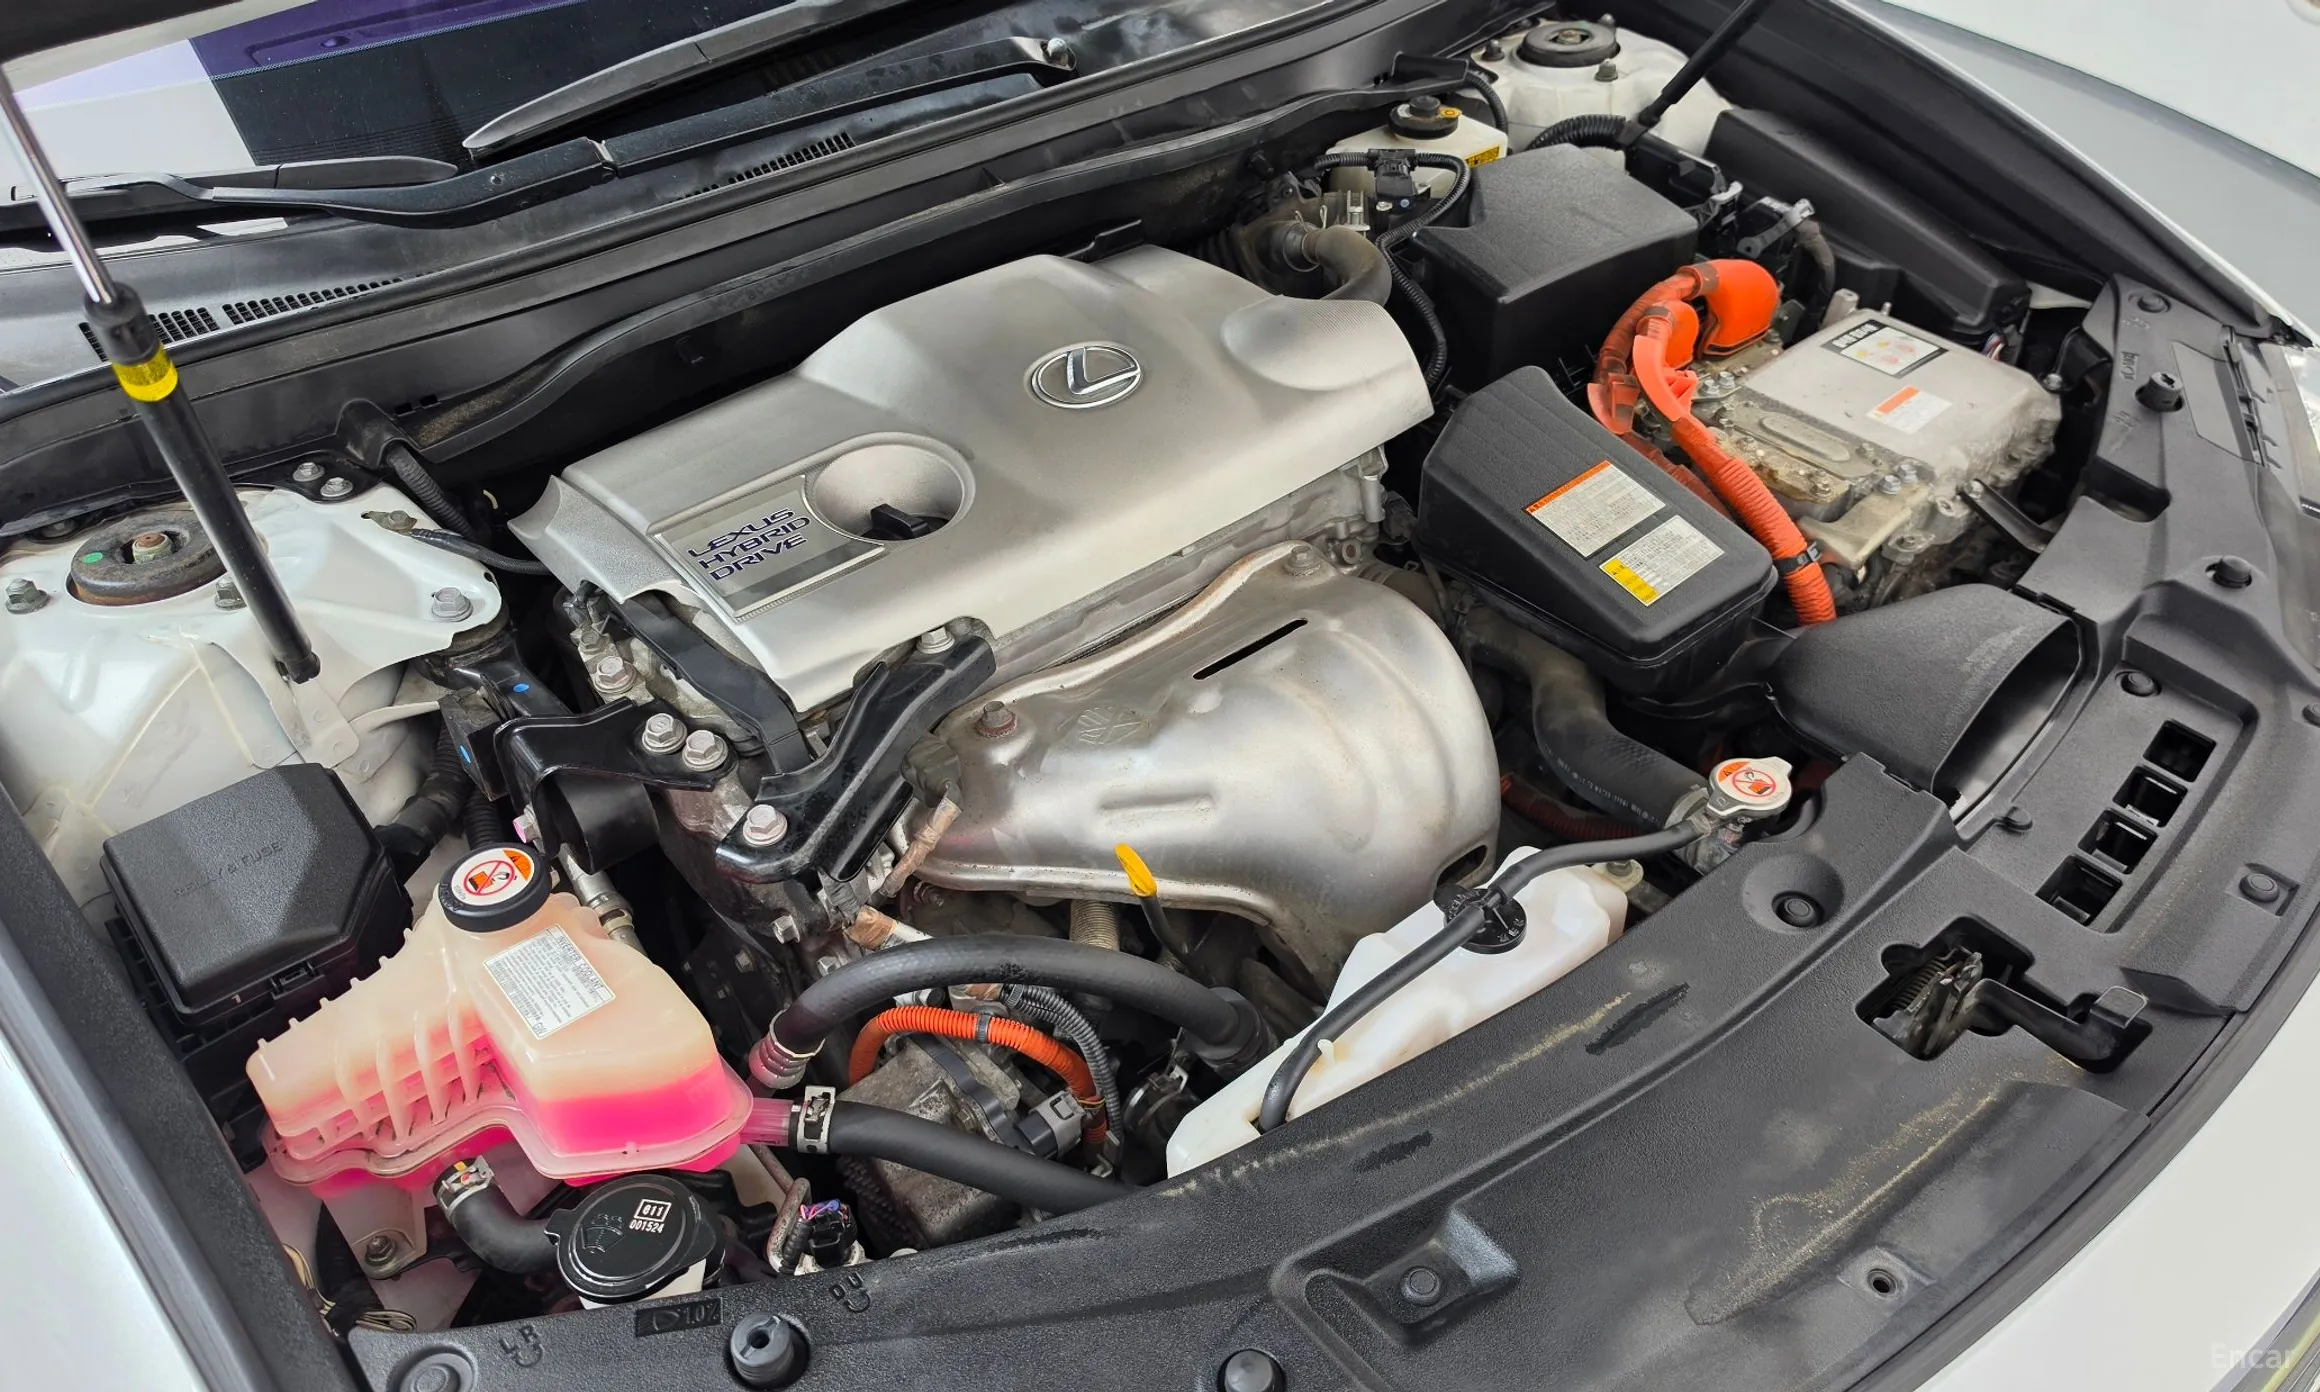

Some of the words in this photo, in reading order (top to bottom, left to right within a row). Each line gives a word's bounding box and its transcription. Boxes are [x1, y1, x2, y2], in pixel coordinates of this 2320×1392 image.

[687, 507, 795, 558] LEXUS
[698, 516, 811, 570] HYBRID
[708, 533, 808, 581] DRIVE
[241, 841, 283, 865] FUSE
[629, 1219, 665, 1234] 001524
[519, 1325, 540, 1343] R
